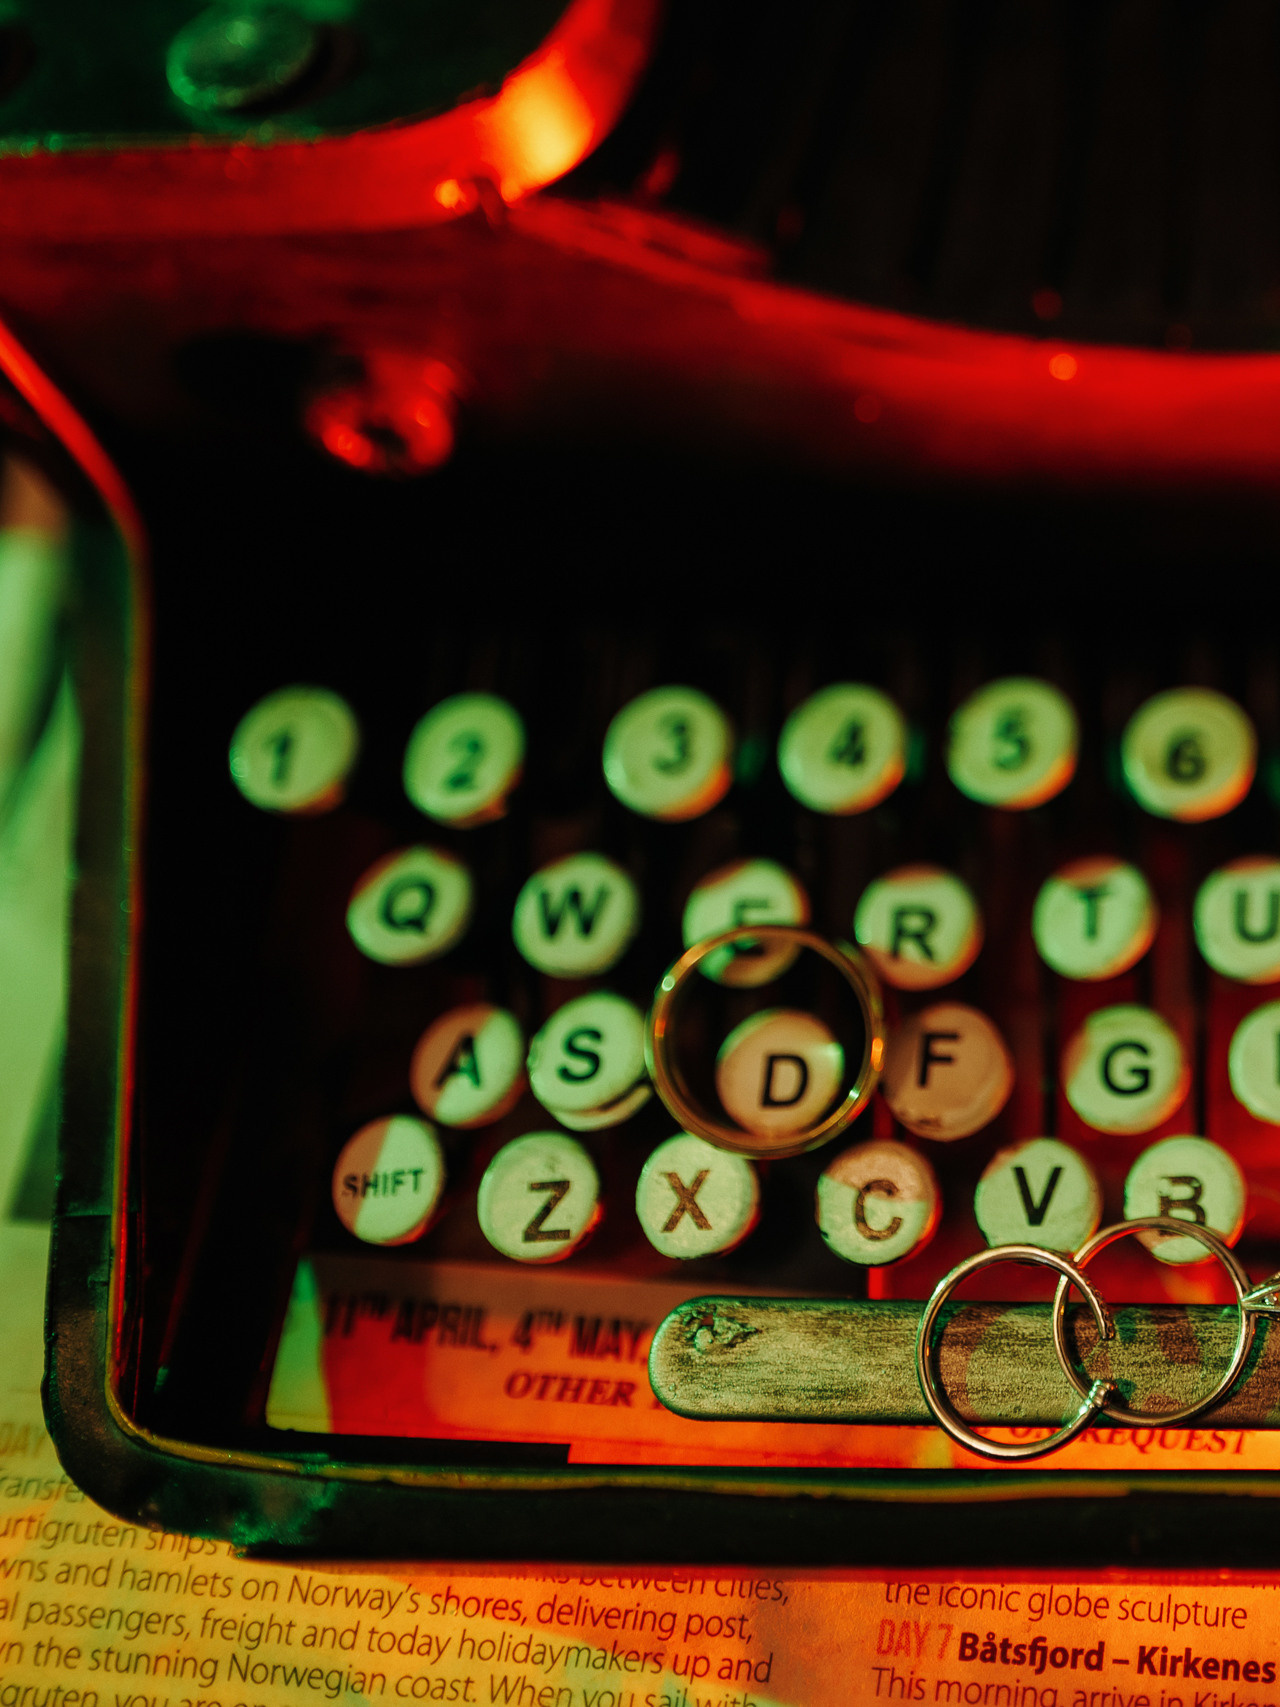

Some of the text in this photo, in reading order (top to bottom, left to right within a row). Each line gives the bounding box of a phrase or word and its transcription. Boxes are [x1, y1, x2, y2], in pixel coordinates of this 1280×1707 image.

[263, 725, 294, 791] 1
[444, 728, 488, 792] 2
[651, 710, 692, 776] 3
[825, 713, 868, 770] 4
[991, 706, 1034, 771] 5
[1163, 730, 1207, 785] 6
[378, 873, 437, 937] Q
[535, 884, 610, 944] W
[890, 903, 940, 963] R
[1072, 884, 1111, 942] T
[433, 1033, 483, 1092] A
[557, 1027, 603, 1085] S
[759, 1053, 809, 1109] D
[917, 1031, 964, 1090] F
[1101, 1040, 1152, 1096] G
[341, 1166, 427, 1200] SHIFT
[521, 1178, 573, 1244] Z
[660, 1168, 714, 1234] X
[852, 1177, 904, 1243] C
[1012, 1164, 1065, 1228] V
[1158, 1174, 1207, 1237] B
[391, 1297, 498, 1355] APRIL,
[511, 1308, 563, 1355] 4TH
[504, 1370, 639, 1408] OTHER
[55, 1558, 113, 1588] and
[118, 1559, 234, 1599] hamlets
[241, 1578, 279, 1602] on
[287, 1575, 421, 1619] Norway's
[428, 1586, 527, 1627] shores,
[536, 1594, 678, 1642] delivering
[683, 1612, 753, 1645] post,
[937, 1583, 1021, 1613] iconic
[1027, 1584, 1110, 1622] globe
[1117, 1593, 1248, 1631] sculpture
[23, 1601, 190, 1642] passengers,
[200, 1607, 296, 1650] freight
[302, 1620, 361, 1650] and
[368, 1624, 451, 1666] today
[458, 1628, 664, 1675] holidaymakers
[672, 1655, 711, 1685] up
[717, 1652, 774, 1684] and
[33, 1636, 81, 1670] the
[88, 1646, 219, 1688] stunning
[227, 1652, 386, 1699] Norwegian
[395, 1673, 477, 1703] coast.
[489, 1674, 573, 1707] When
[876, 1618, 930, 1658] DAY
[937, 1622, 954, 1660] 7
[958, 1631, 1105, 1676] Båtsfjord
[1137, 1645, 1277, 1685] Kirkenes
[872, 1666, 926, 1700] This
[935, 1678, 1062, 1707] morning
[1072, 1686, 1150, 1707] arrive
[1160, 1689, 1184, 1707] in
